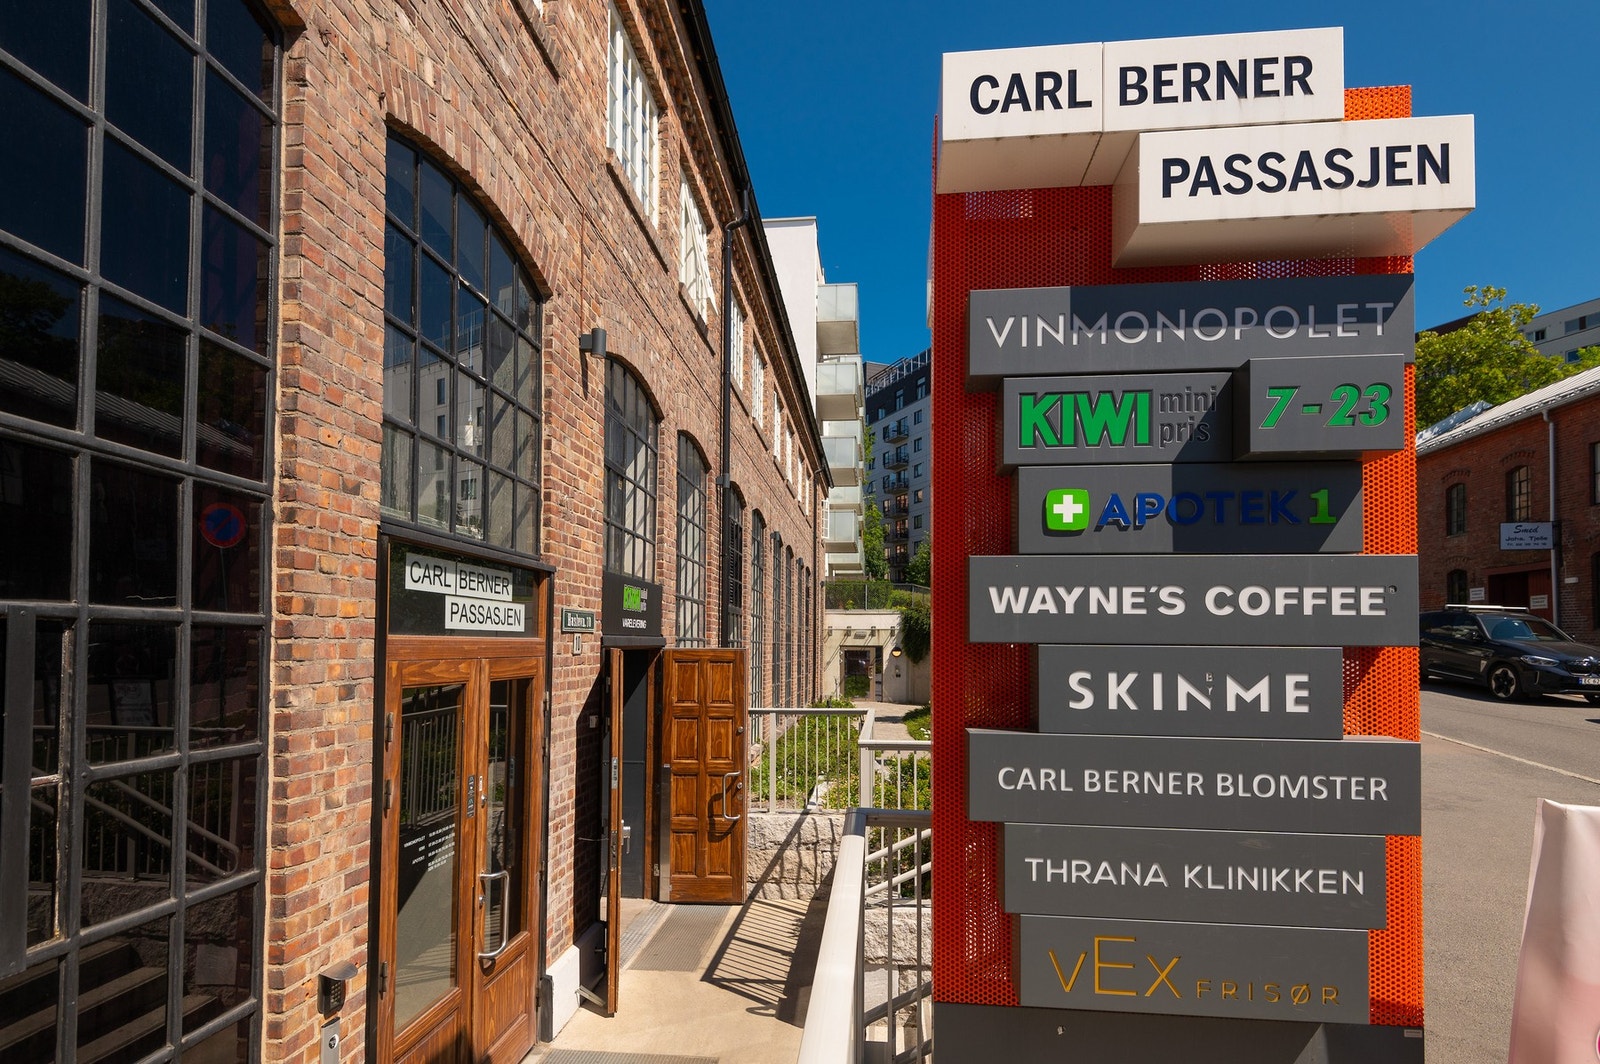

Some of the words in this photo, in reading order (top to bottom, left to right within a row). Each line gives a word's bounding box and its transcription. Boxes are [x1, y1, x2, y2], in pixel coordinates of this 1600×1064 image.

[969, 69, 1093, 115] CARL
[1119, 55, 1314, 106] BERNER
[1161, 142, 1450, 198] PASSASJEN
[985, 302, 1395, 348] VINMONOPOLET
[1158, 385, 1217, 413] mini
[1018, 388, 1153, 449] KIWI
[1158, 416, 1210, 448] pris
[1098, 490, 1302, 527] APOTEK
[1308, 489, 1337, 524] 1
[409, 561, 452, 588] CARL
[459, 569, 510, 596] BERNER
[450, 602, 521, 627] PASSASJEN
[988, 585, 1187, 616] WAYNE'S
[1068, 672, 1212, 711] SKIN
[1226, 673, 1311, 713] ME
[997, 767, 1073, 792] CARL
[1083, 769, 1205, 797] BERNER
[1216, 772, 1389, 801] BLOMSTER
[1024, 857, 1169, 888] THRANA
[1184, 864, 1365, 895] KLINIKKEN
[1196, 979, 1340, 1005] FRISØR
